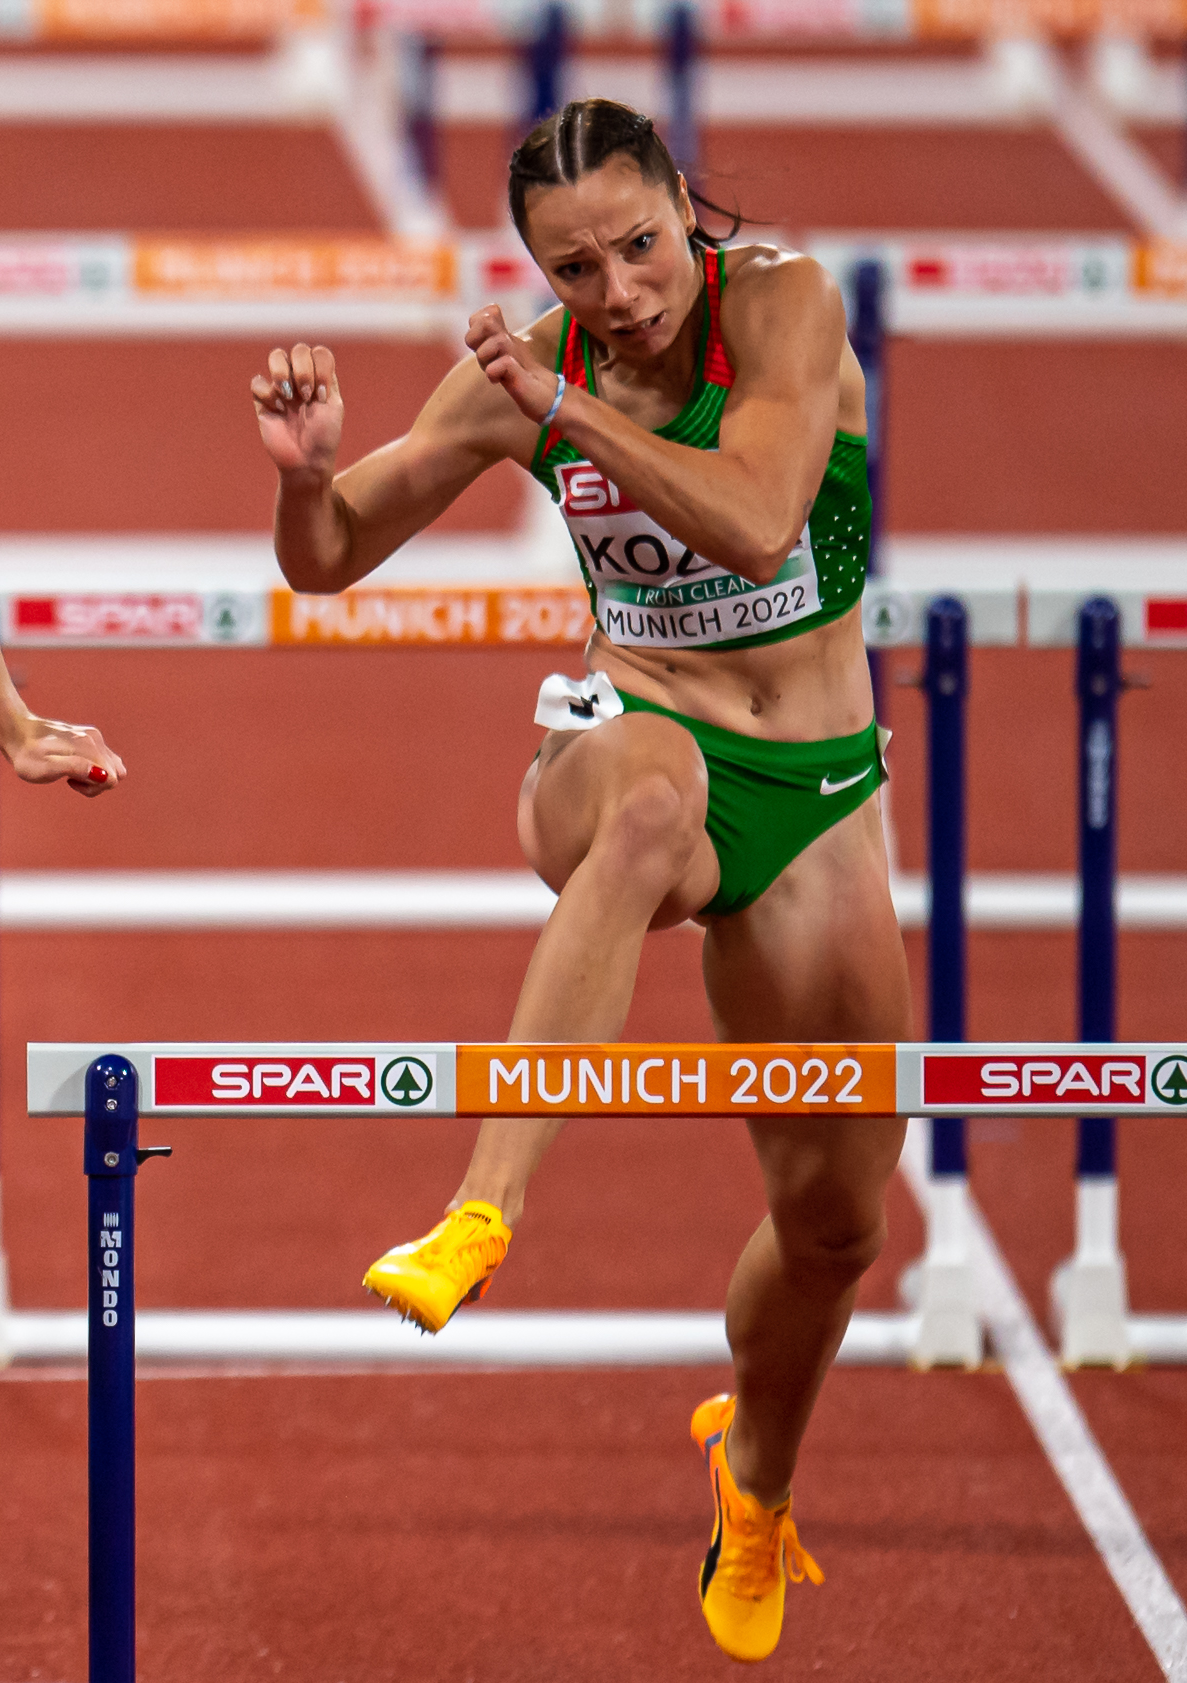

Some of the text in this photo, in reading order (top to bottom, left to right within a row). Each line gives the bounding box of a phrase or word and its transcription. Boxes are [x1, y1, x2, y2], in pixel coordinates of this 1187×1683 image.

[500, 596, 594, 641] 202
[606, 585, 806, 639] MUNICH 2022
[644, 588, 685, 607] RUN
[211, 1058, 1142, 1104] SPAR MUNICH 2022 SPAR
[99, 1230, 122, 1328] MONDO
